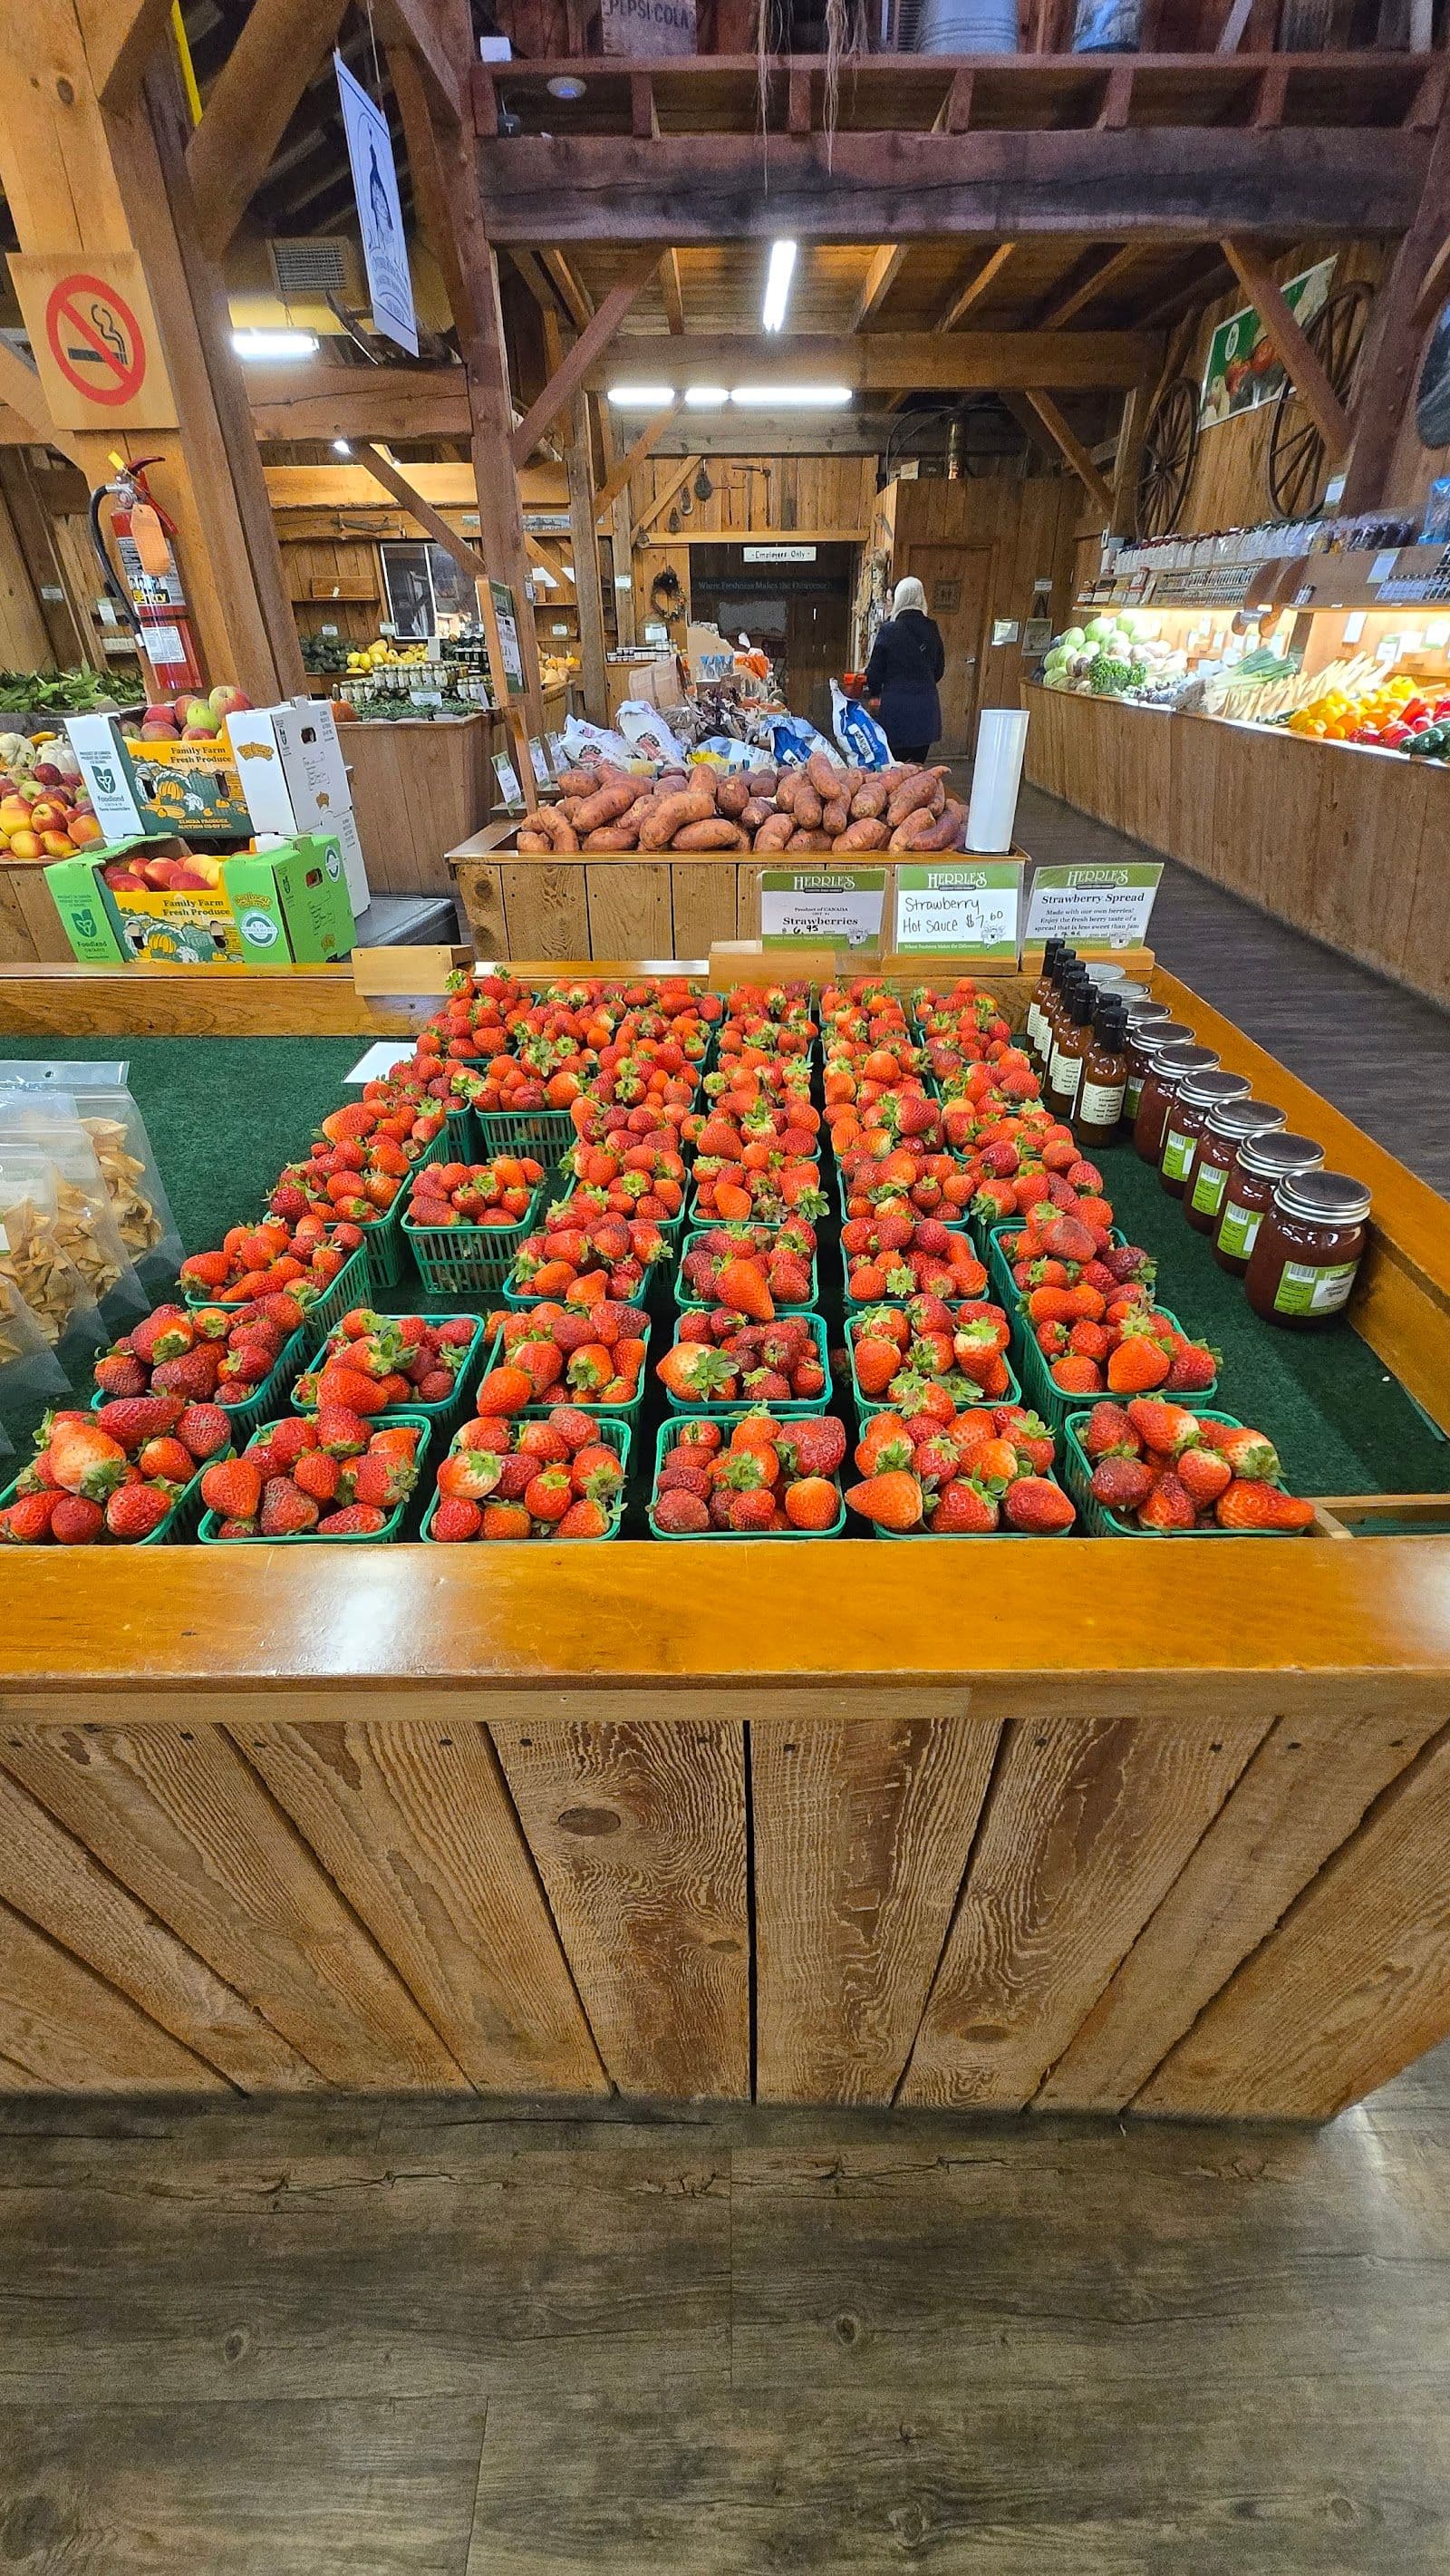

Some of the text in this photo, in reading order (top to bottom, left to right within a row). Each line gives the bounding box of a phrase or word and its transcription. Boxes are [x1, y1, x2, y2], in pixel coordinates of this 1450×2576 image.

[170, 747, 200, 755] Family
[793, 876, 856, 890] HERRLE'S
[927, 872, 987, 888] HERRLE'S
[1067, 869, 1128, 886] HERRLE'S
[163, 899, 196, 907] Family
[905, 896, 980, 915] Strawberry
[1041, 893, 1145, 905] Strawberry Spread
[782, 917, 858, 925] Strawberries
[903, 916, 921, 934] Hot
